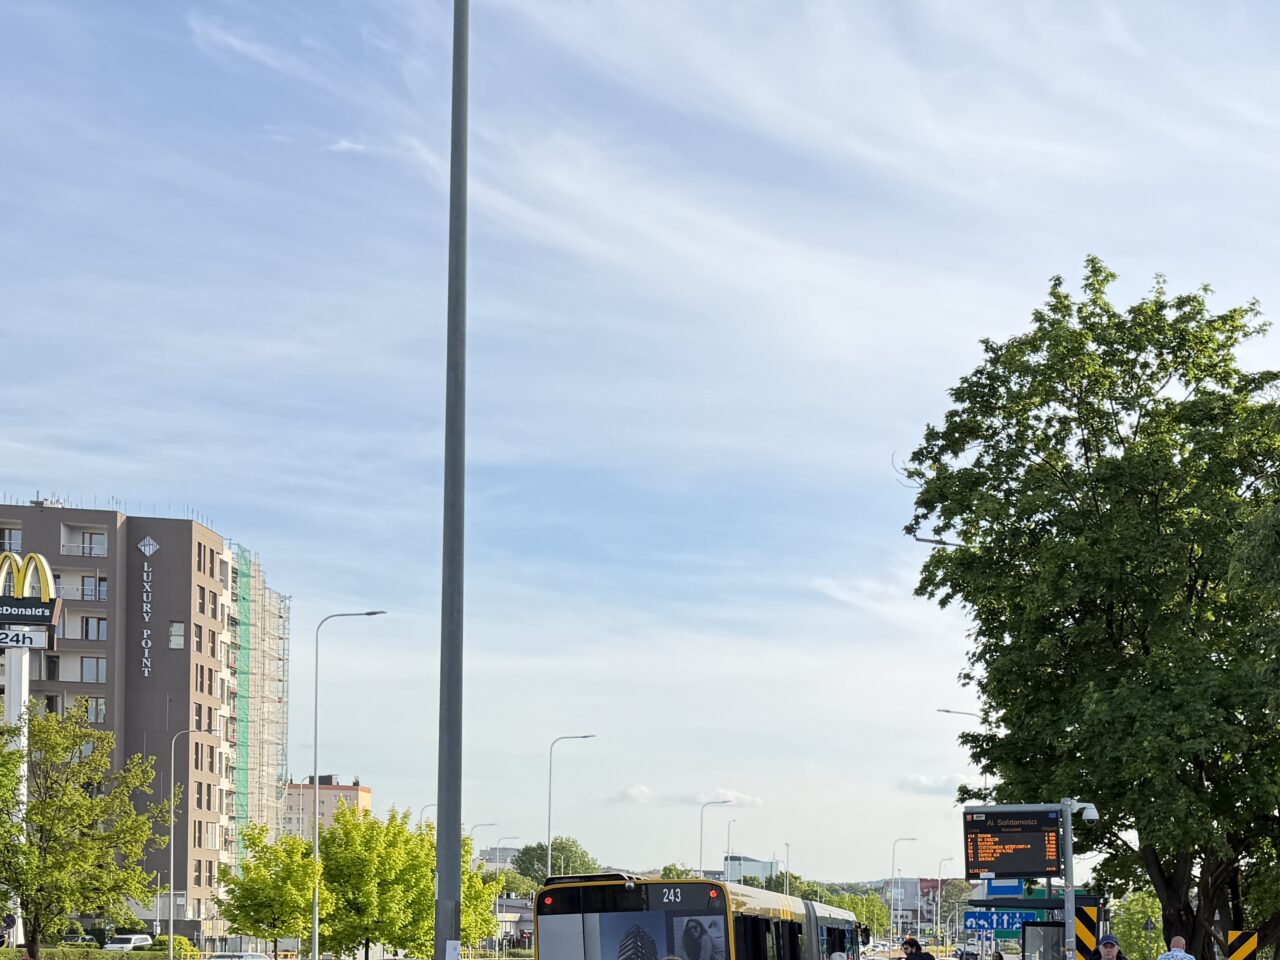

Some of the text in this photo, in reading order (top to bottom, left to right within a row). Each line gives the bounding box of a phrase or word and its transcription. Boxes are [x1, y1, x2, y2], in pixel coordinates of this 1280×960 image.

[141, 561, 152, 677] LUXURY POINT
[0, 632, 33, 645] 24h
[662, 888, 682, 903] 243
